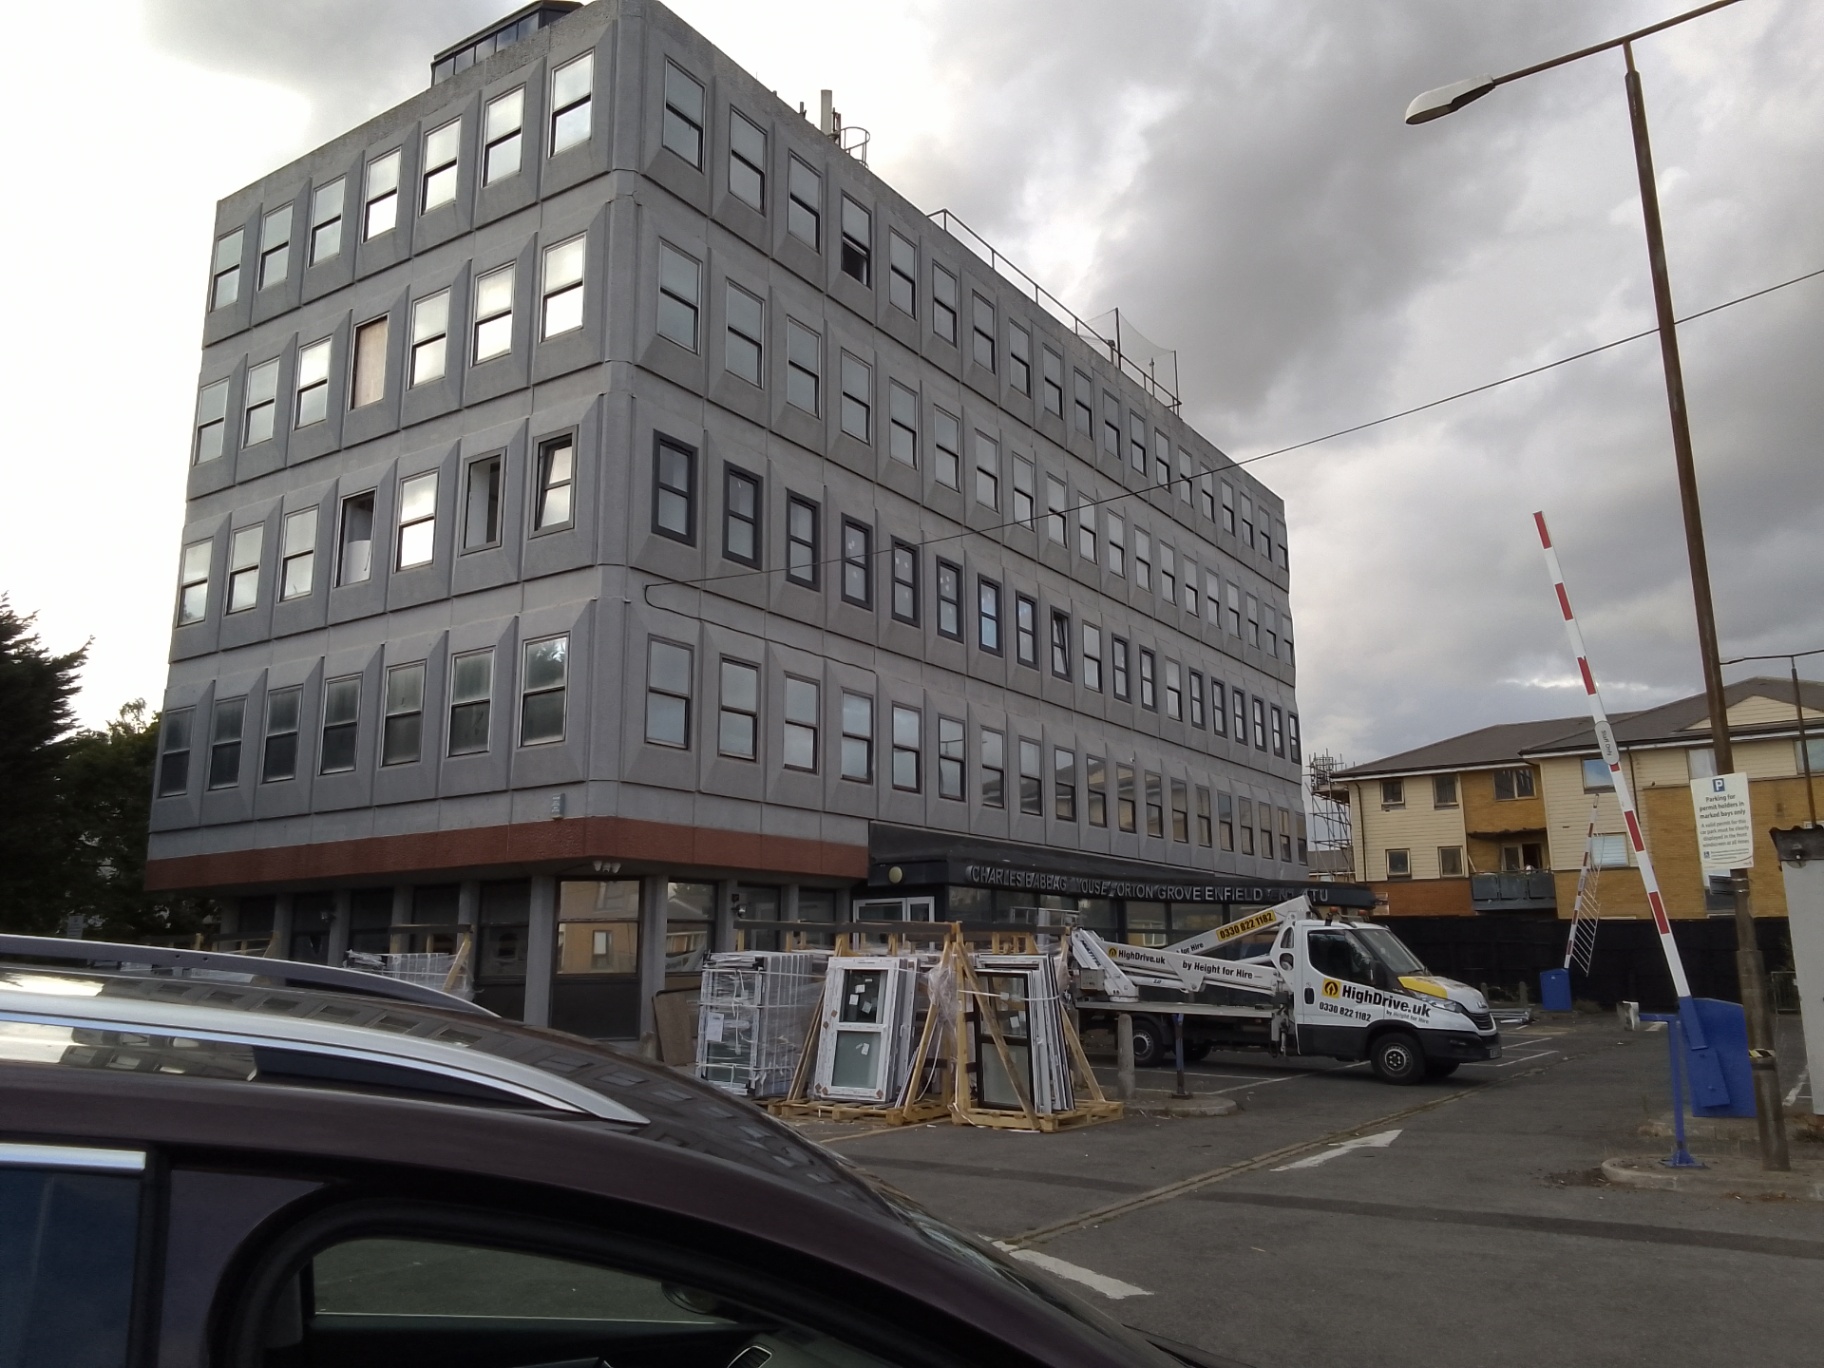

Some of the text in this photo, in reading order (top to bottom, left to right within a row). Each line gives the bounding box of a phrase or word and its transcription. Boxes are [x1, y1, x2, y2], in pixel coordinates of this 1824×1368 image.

[1715, 779, 1723, 791] P
[1699, 804, 1717, 812] permit
[1705, 795, 1727, 803] Parking
[970, 865, 1022, 887] CHARLES
[1024, 872, 1075, 892] BABBAG
[1157, 885, 1202, 901] GROVE
[1204, 885, 1264, 901] ENFIELD
[1219, 912, 1274, 939] 0330 822 1182
[1190, 942, 1204, 952] Hire
[1118, 949, 1166, 965] HighDrive.uk
[1182, 959, 1193, 971] by
[1194, 961, 1221, 975] Height
[1222, 965, 1235, 976] for
[1236, 967, 1253, 979] Hire
[1341, 984, 1431, 1018] HighDrive.uk
[1319, 1001, 1372, 1022] 0330 822 1182
